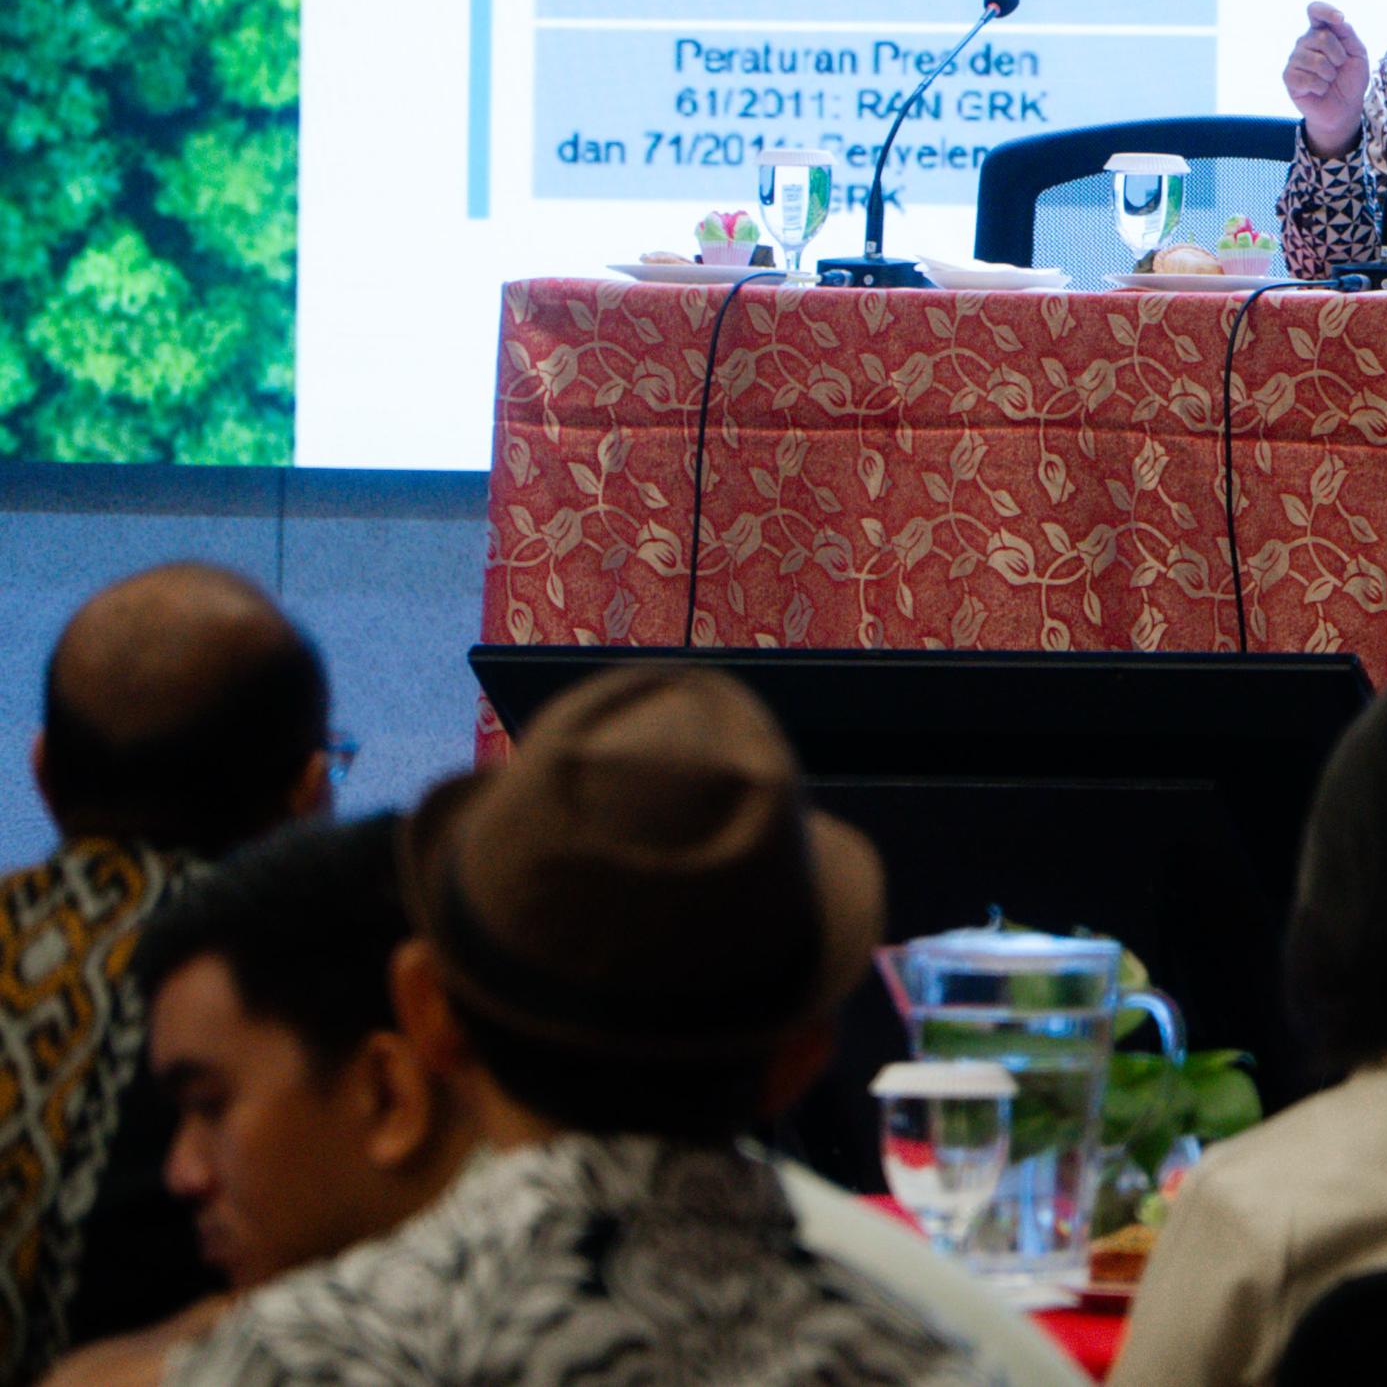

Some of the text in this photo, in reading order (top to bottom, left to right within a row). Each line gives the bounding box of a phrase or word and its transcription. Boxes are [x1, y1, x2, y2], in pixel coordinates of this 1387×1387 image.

[674, 37, 1039, 77] Peraturan Presiden
[856, 88, 943, 121] RAN
[956, 89, 1050, 123] GRK
[556, 131, 627, 165] dan
